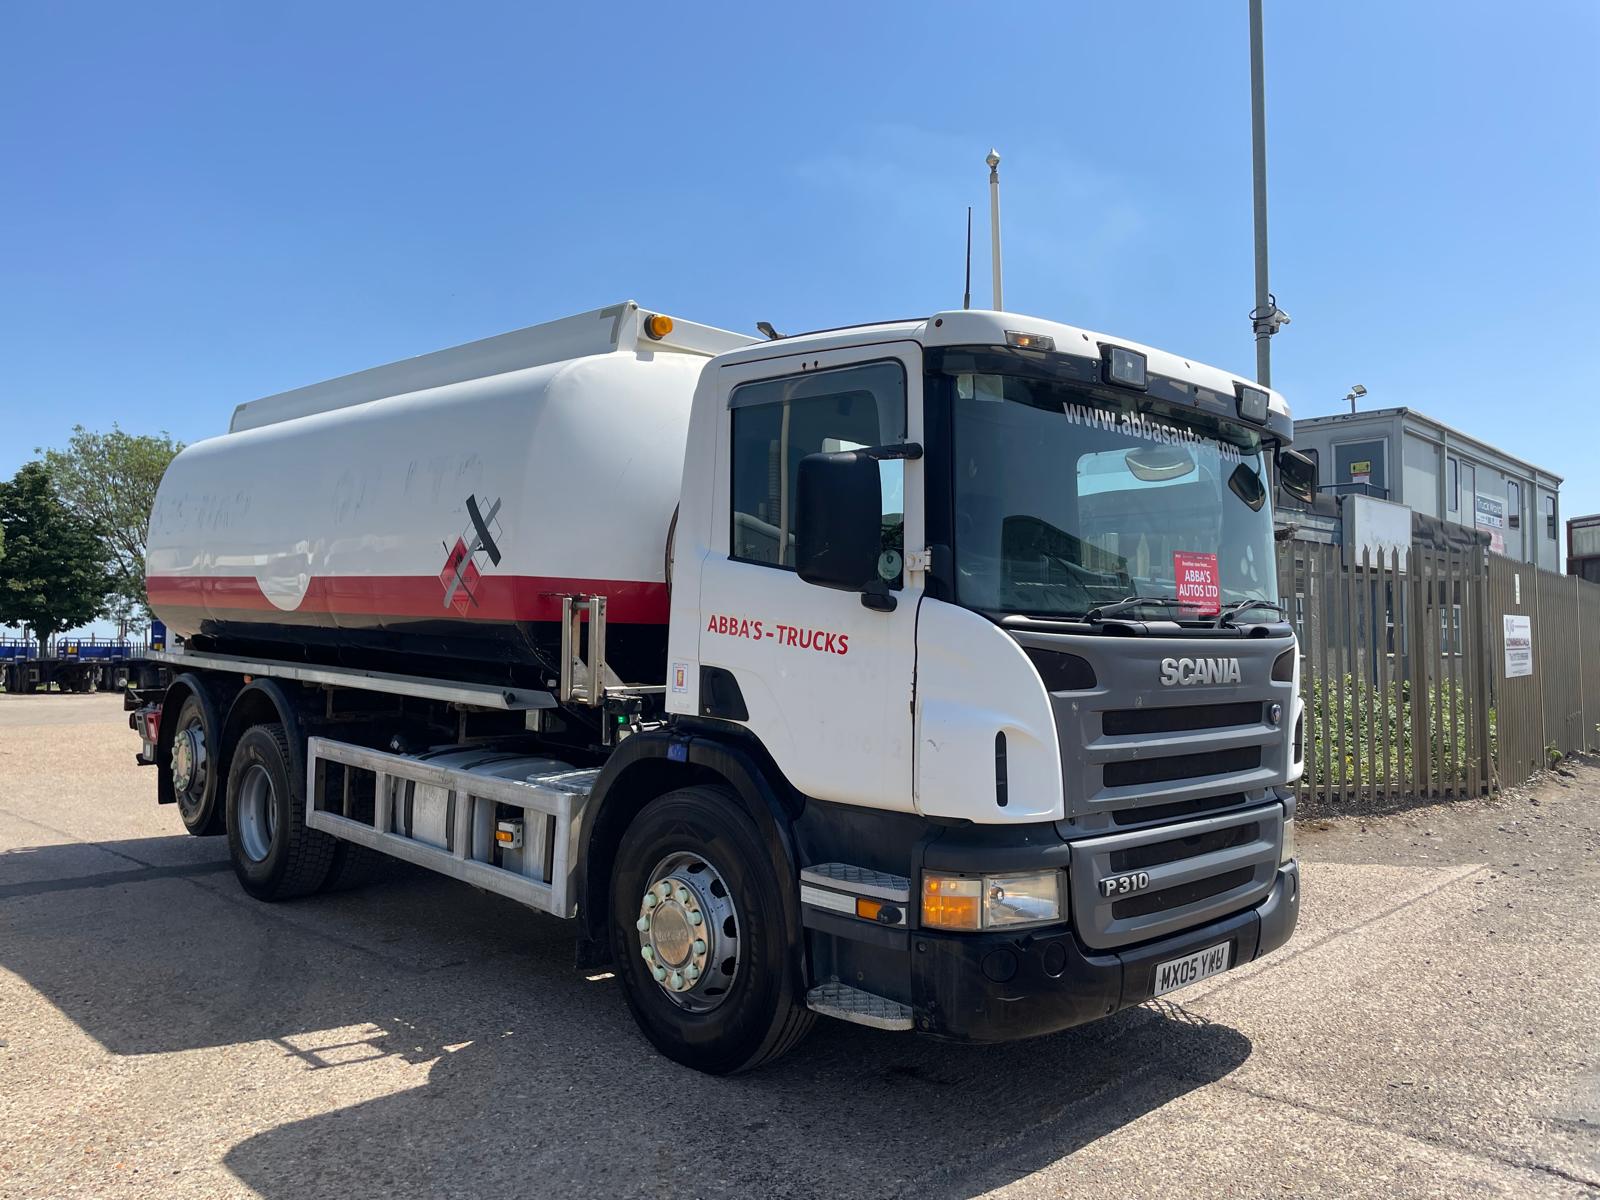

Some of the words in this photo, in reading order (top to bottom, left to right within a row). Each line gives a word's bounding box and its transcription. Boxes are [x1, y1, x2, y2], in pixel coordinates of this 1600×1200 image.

[1062, 401, 1242, 465] www.abbasautocom
[1184, 569, 1211, 583] ABBA'S
[1179, 584, 1204, 597] AUTOS
[1205, 585, 1218, 598] LTD
[1160, 657, 1242, 686] SCANIA
[1160, 956, 1199, 991] MX05
